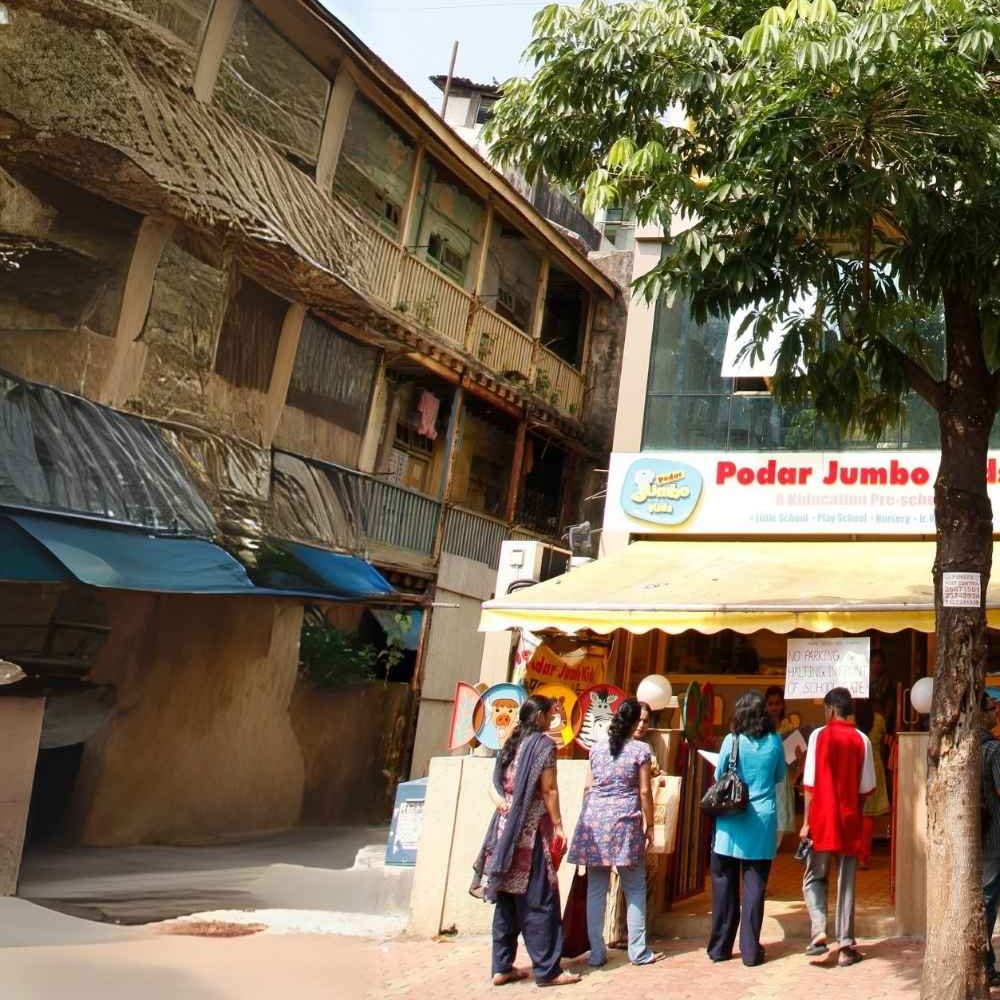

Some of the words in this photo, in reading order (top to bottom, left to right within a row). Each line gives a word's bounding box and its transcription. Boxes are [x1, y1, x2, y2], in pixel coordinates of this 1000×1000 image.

[658, 472, 683, 483] Podar
[716, 460, 812, 485] Podar
[823, 460, 929, 485] Jumbo
[631, 483, 690, 503] Jumbo
[804, 649, 840, 662] PARKING
